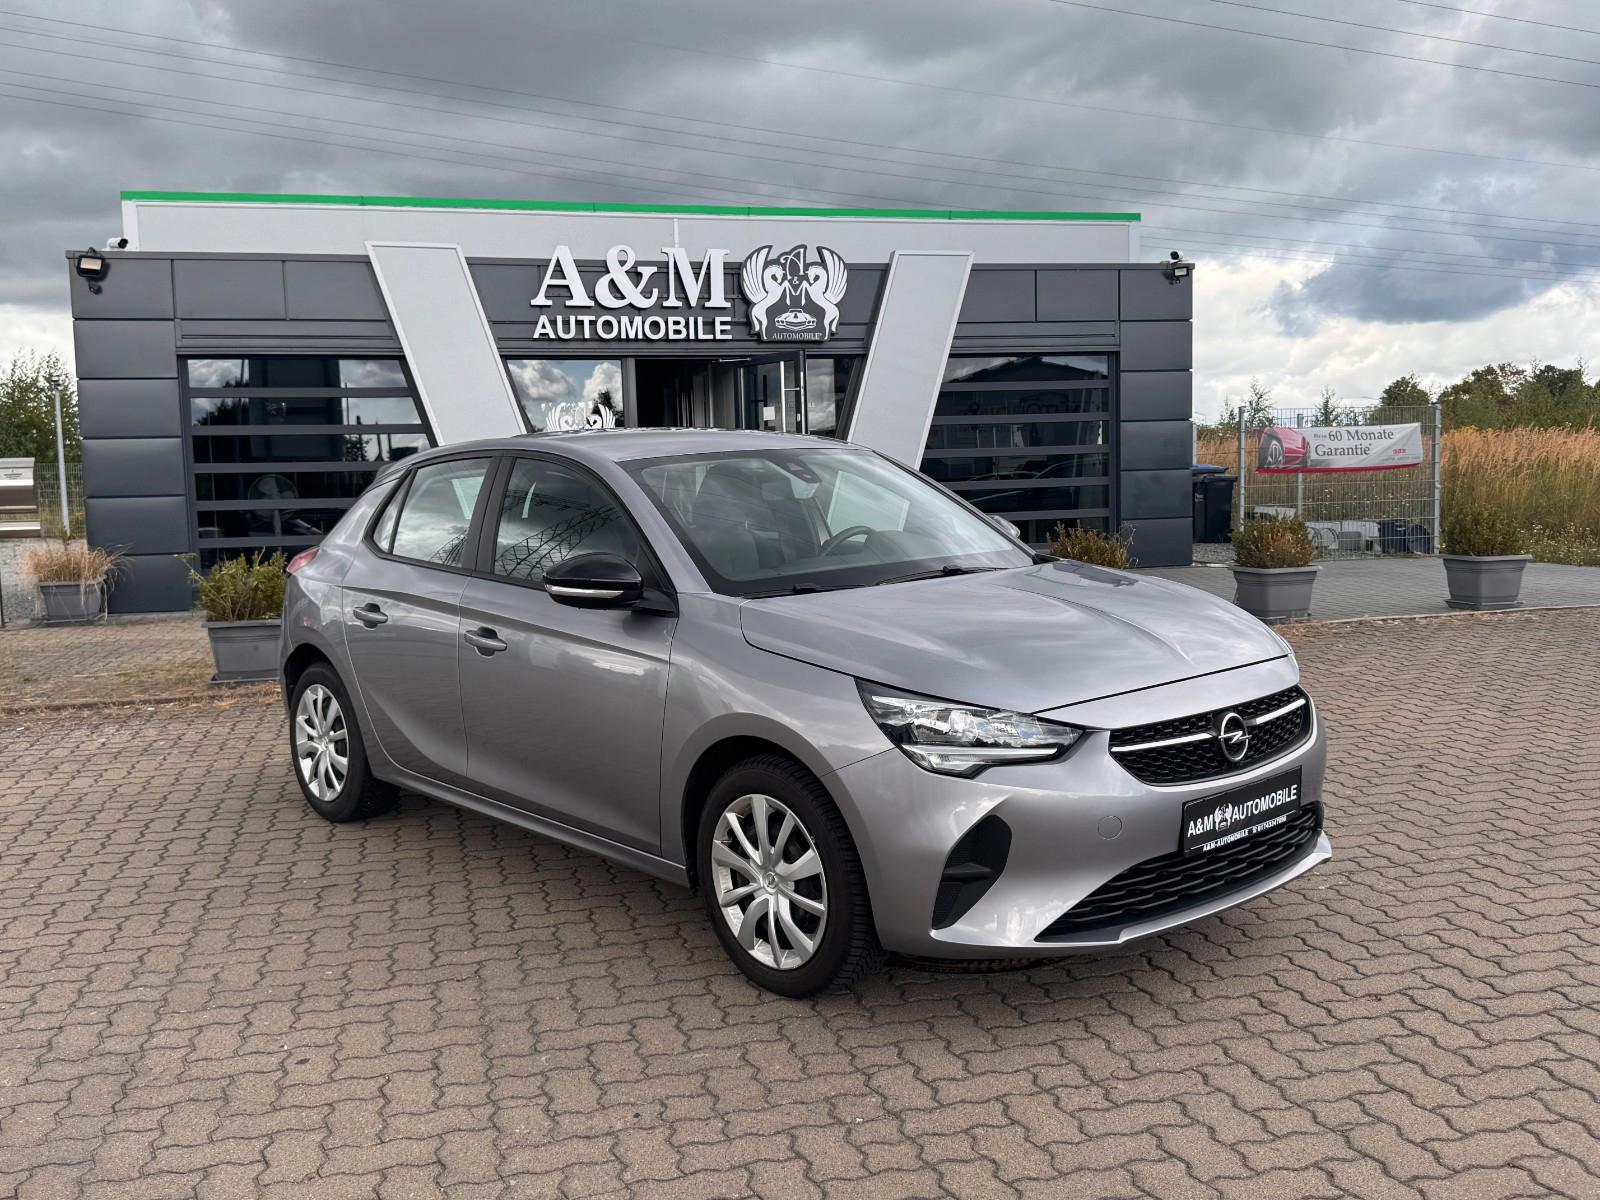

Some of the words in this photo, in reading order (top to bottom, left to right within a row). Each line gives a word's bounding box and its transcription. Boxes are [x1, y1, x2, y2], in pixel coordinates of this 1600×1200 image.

[530, 245, 732, 309] A&M
[533, 315, 732, 340] AUTOMOBILE
[1328, 430, 1343, 442] 60
[1345, 429, 1394, 441] Monate
[1187, 814, 1214, 838] A&M
[1232, 784, 1297, 822] AUTOMOBILE
